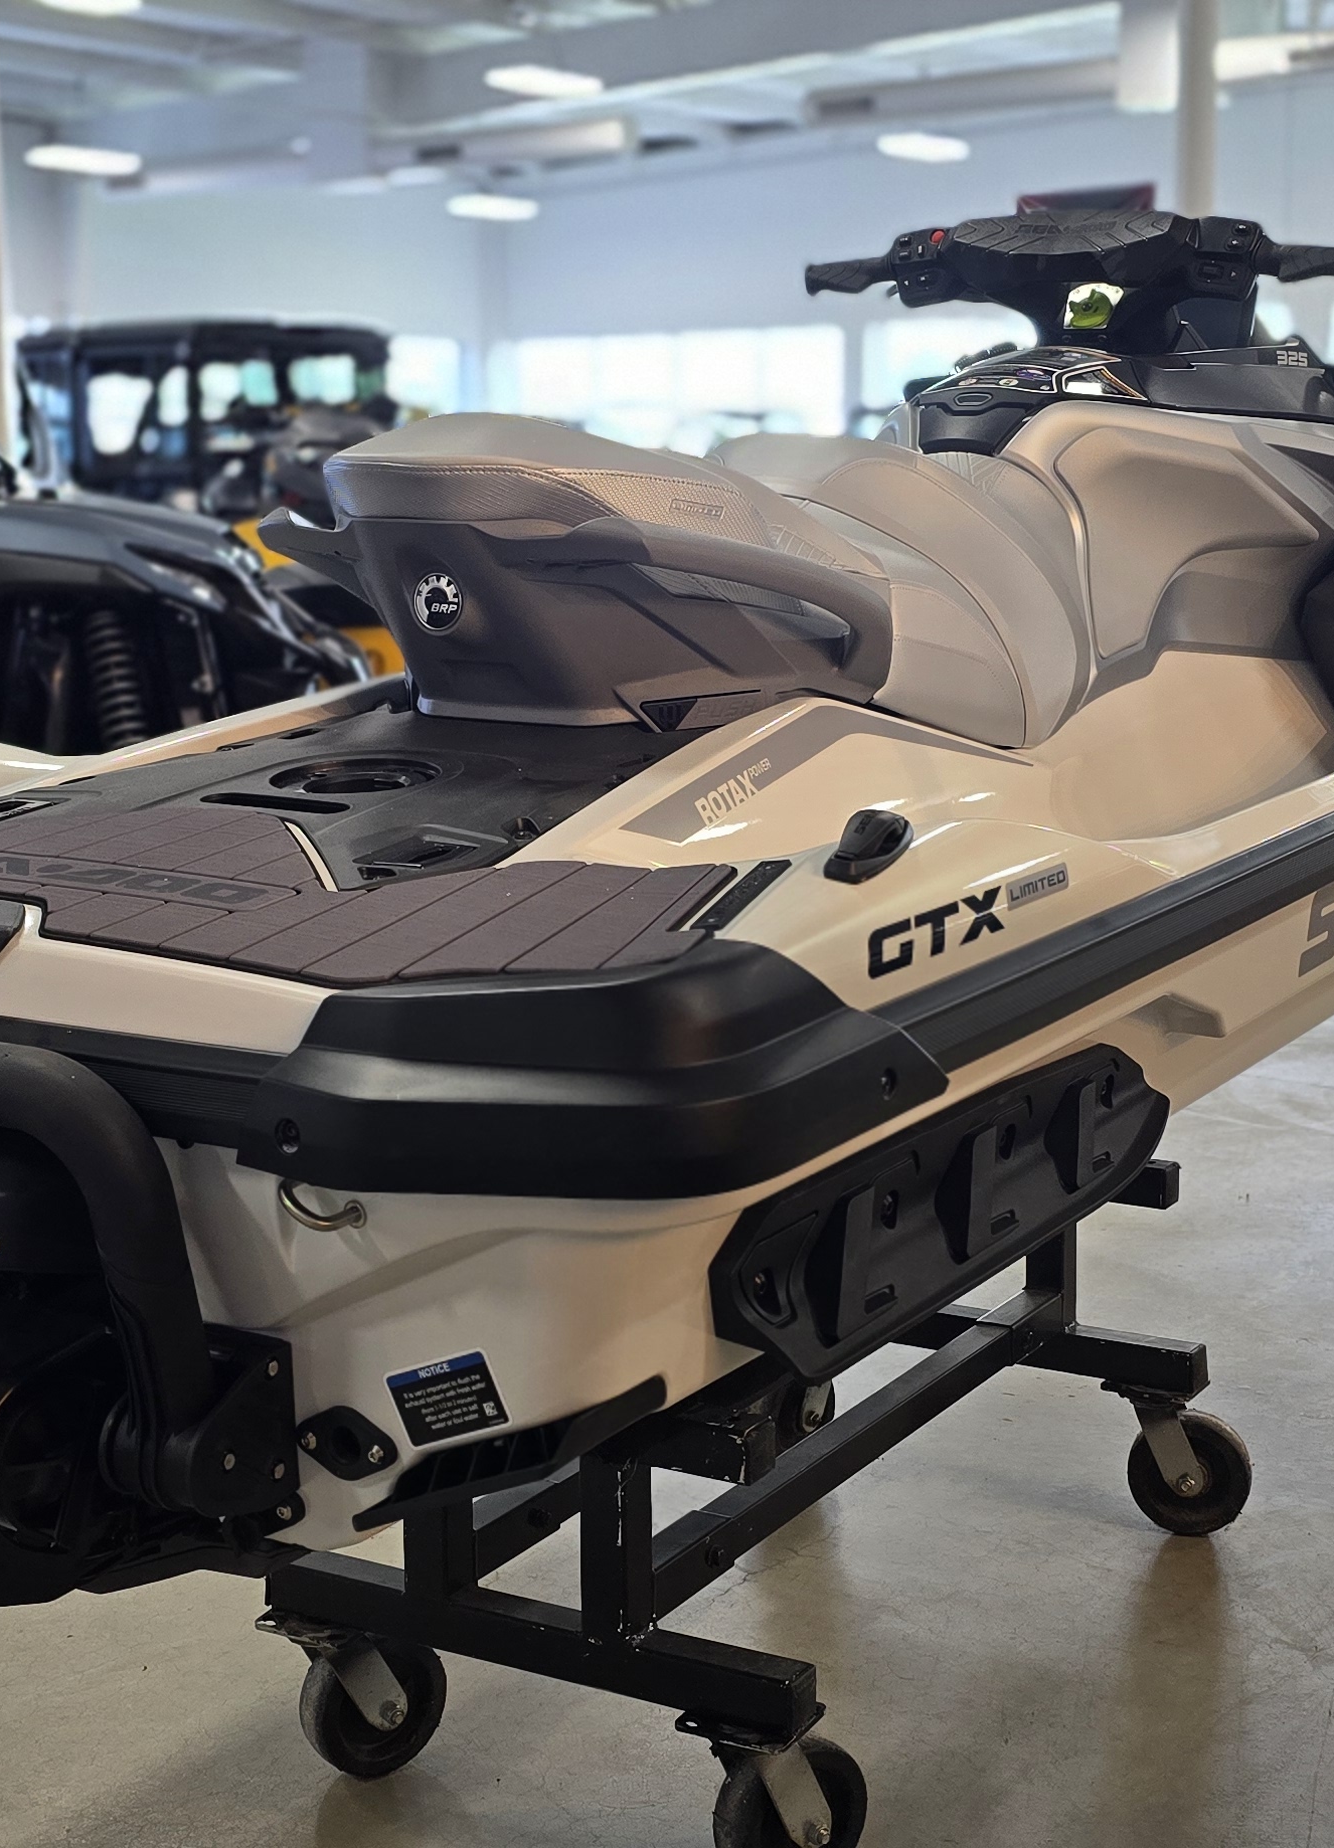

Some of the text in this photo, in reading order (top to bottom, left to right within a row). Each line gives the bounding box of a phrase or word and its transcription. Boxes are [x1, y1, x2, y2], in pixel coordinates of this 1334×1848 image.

[1276, 350, 1308, 367] 325
[431, 602, 458, 614] BRP
[694, 757, 772, 828] ROTAX POWER
[868, 869, 1067, 980] GTX LIMITED
[418, 1362, 450, 1379] NOTICE
